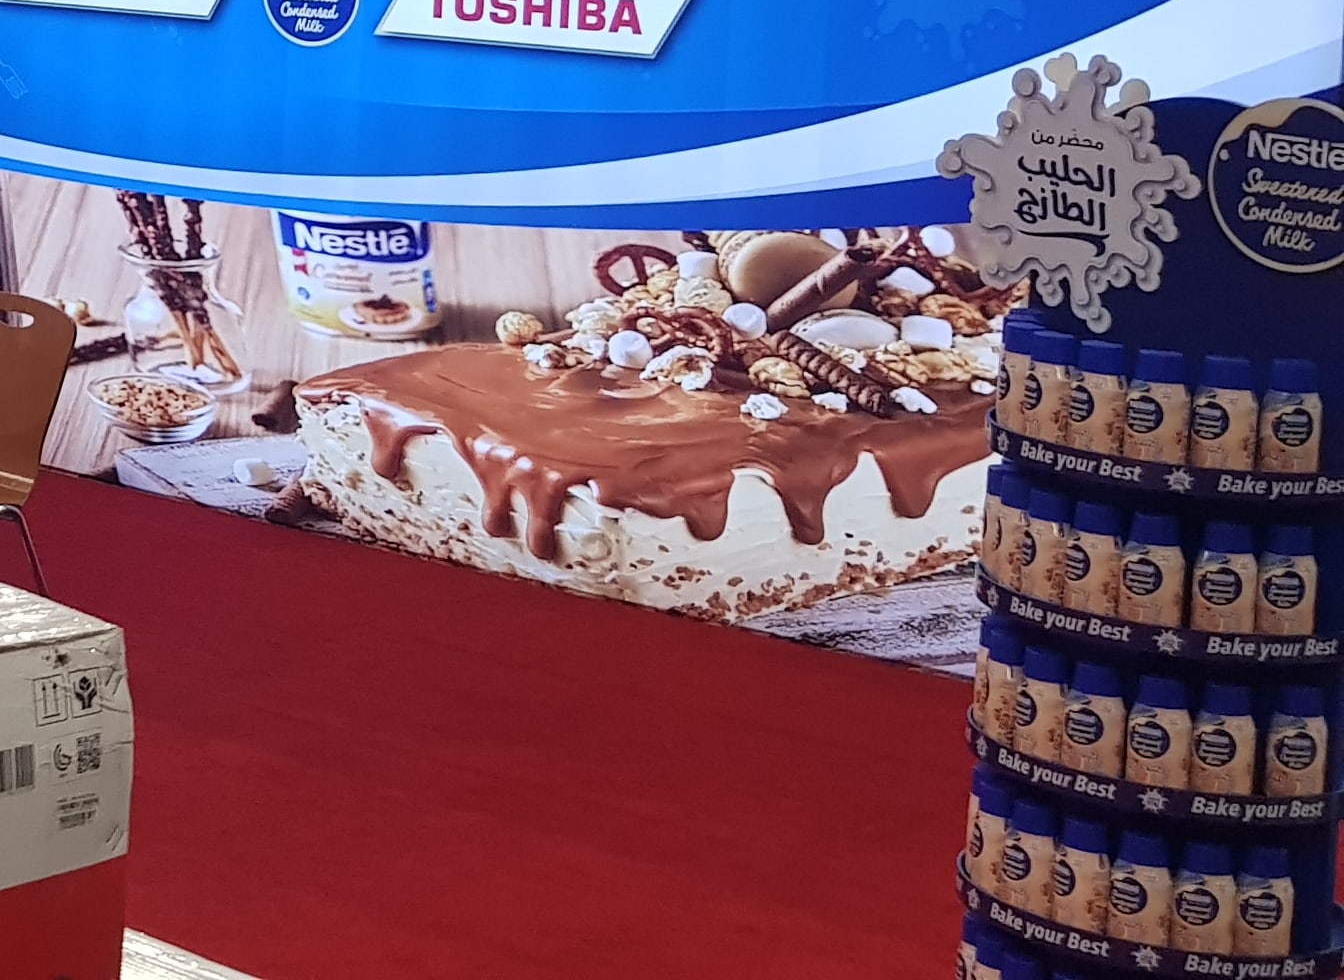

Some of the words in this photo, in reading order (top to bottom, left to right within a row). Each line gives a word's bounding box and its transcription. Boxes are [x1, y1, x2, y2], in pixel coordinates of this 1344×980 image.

[280, 1, 339, 19] Condensed
[294, 18, 325, 33] Milk
[1031, 129, 1054, 145] من
[1017, 153, 1116, 197] الحليب
[1241, 167, 1344, 205] Sweetened
[1013, 187, 1106, 231] الطازج
[1238, 195, 1342, 232] Condensed
[1262, 225, 1316, 252] Milk
[1020, 439, 1055, 466] Bake
[1056, 451, 1097, 476] your
[1098, 458, 1142, 483] Best
[1217, 474, 1268, 494] Bake
[1268, 480, 1314, 500] your
[1009, 597, 1044, 625] Bake
[1045, 608, 1086, 633] your
[1087, 617, 1131, 642] Best
[1206, 636, 1257, 657] Bake
[1257, 640, 1303, 660] your
[1303, 637, 1338, 657] Best
[998, 749, 1030, 776] Bake
[1030, 761, 1072, 788] your
[1075, 776, 1117, 800] Best
[1190, 796, 1241, 817] Bake
[1241, 801, 1288, 822] your
[1288, 799, 1324, 819] Best
[989, 902, 1023, 931] Bake
[1024, 914, 1066, 943] your
[1067, 931, 1110, 958] Best
[1184, 953, 1235, 974] Bake
[1235, 959, 1283, 980] your
[1282, 958, 1316, 977] Best
